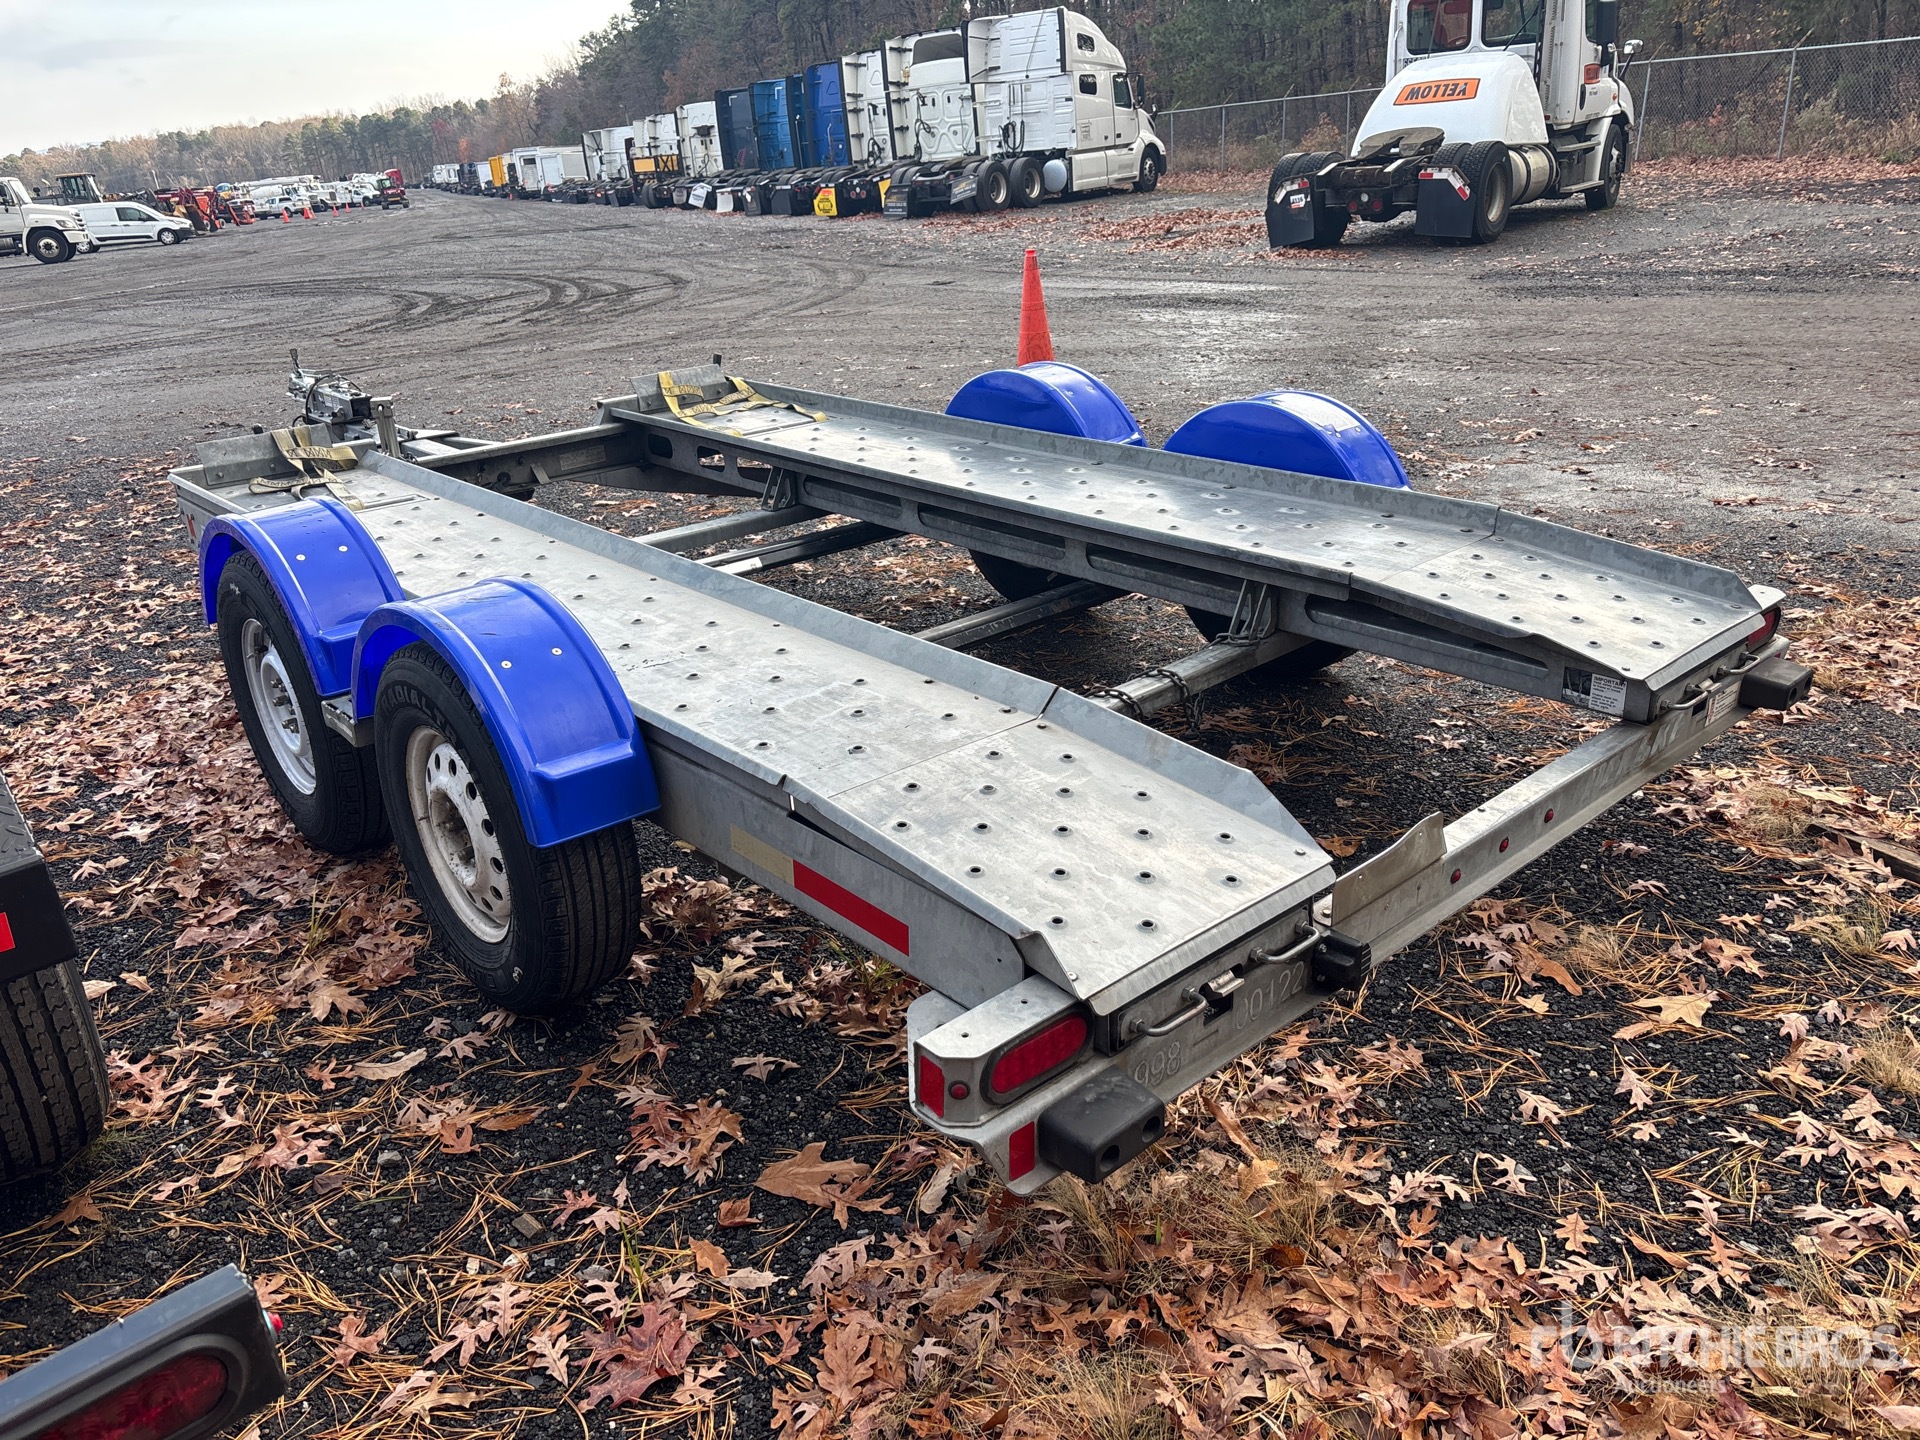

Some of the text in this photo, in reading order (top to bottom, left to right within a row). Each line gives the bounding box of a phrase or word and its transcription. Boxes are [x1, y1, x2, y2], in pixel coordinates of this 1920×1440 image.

[1403, 82, 1469, 101] YELLOW
[381, 684, 432, 717] RADIAL
[1236, 961, 1305, 1030] 00122
